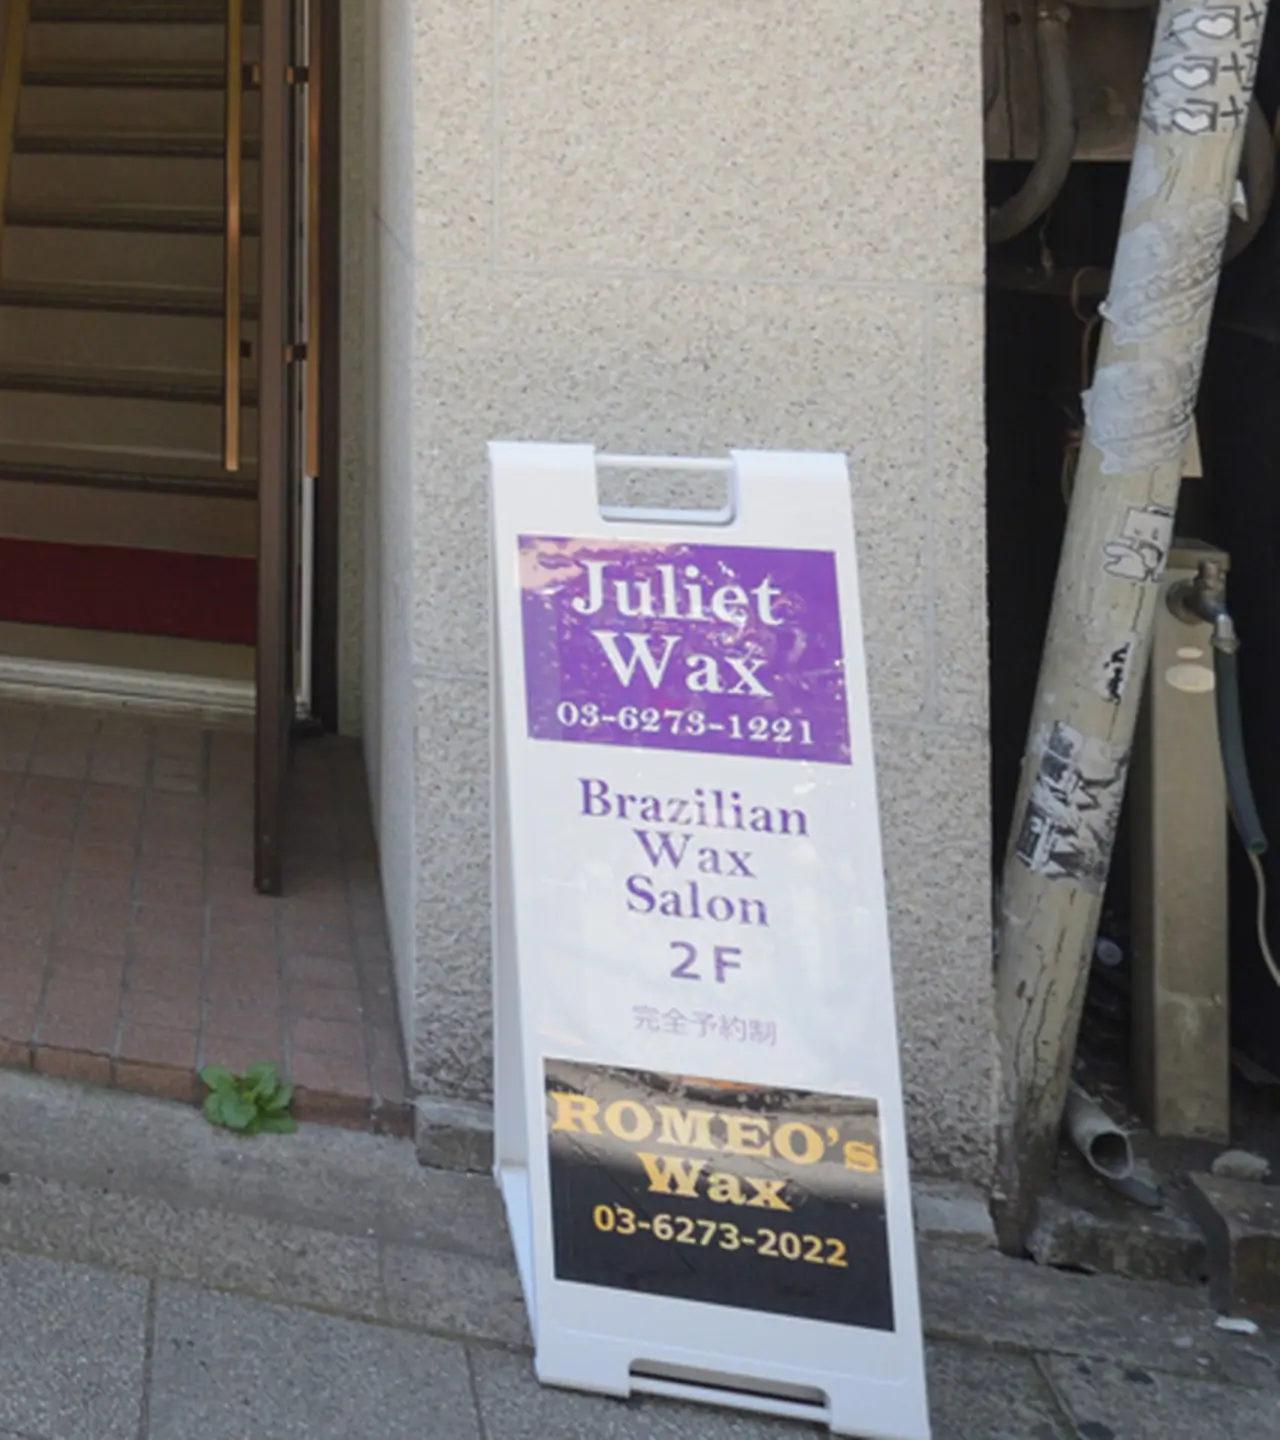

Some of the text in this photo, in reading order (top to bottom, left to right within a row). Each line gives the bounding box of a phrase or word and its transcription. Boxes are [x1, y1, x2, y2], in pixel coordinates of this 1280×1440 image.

[592, 629, 773, 698] Wax
[556, 702, 816, 746] 03-6273-1221
[578, 777, 810, 837] Brazilian
[631, 829, 758, 880] Wax
[625, 875, 770, 927] Salon
[637, 1153, 793, 1212] Wax
[592, 1205, 849, 1269] 03-6273-2022
